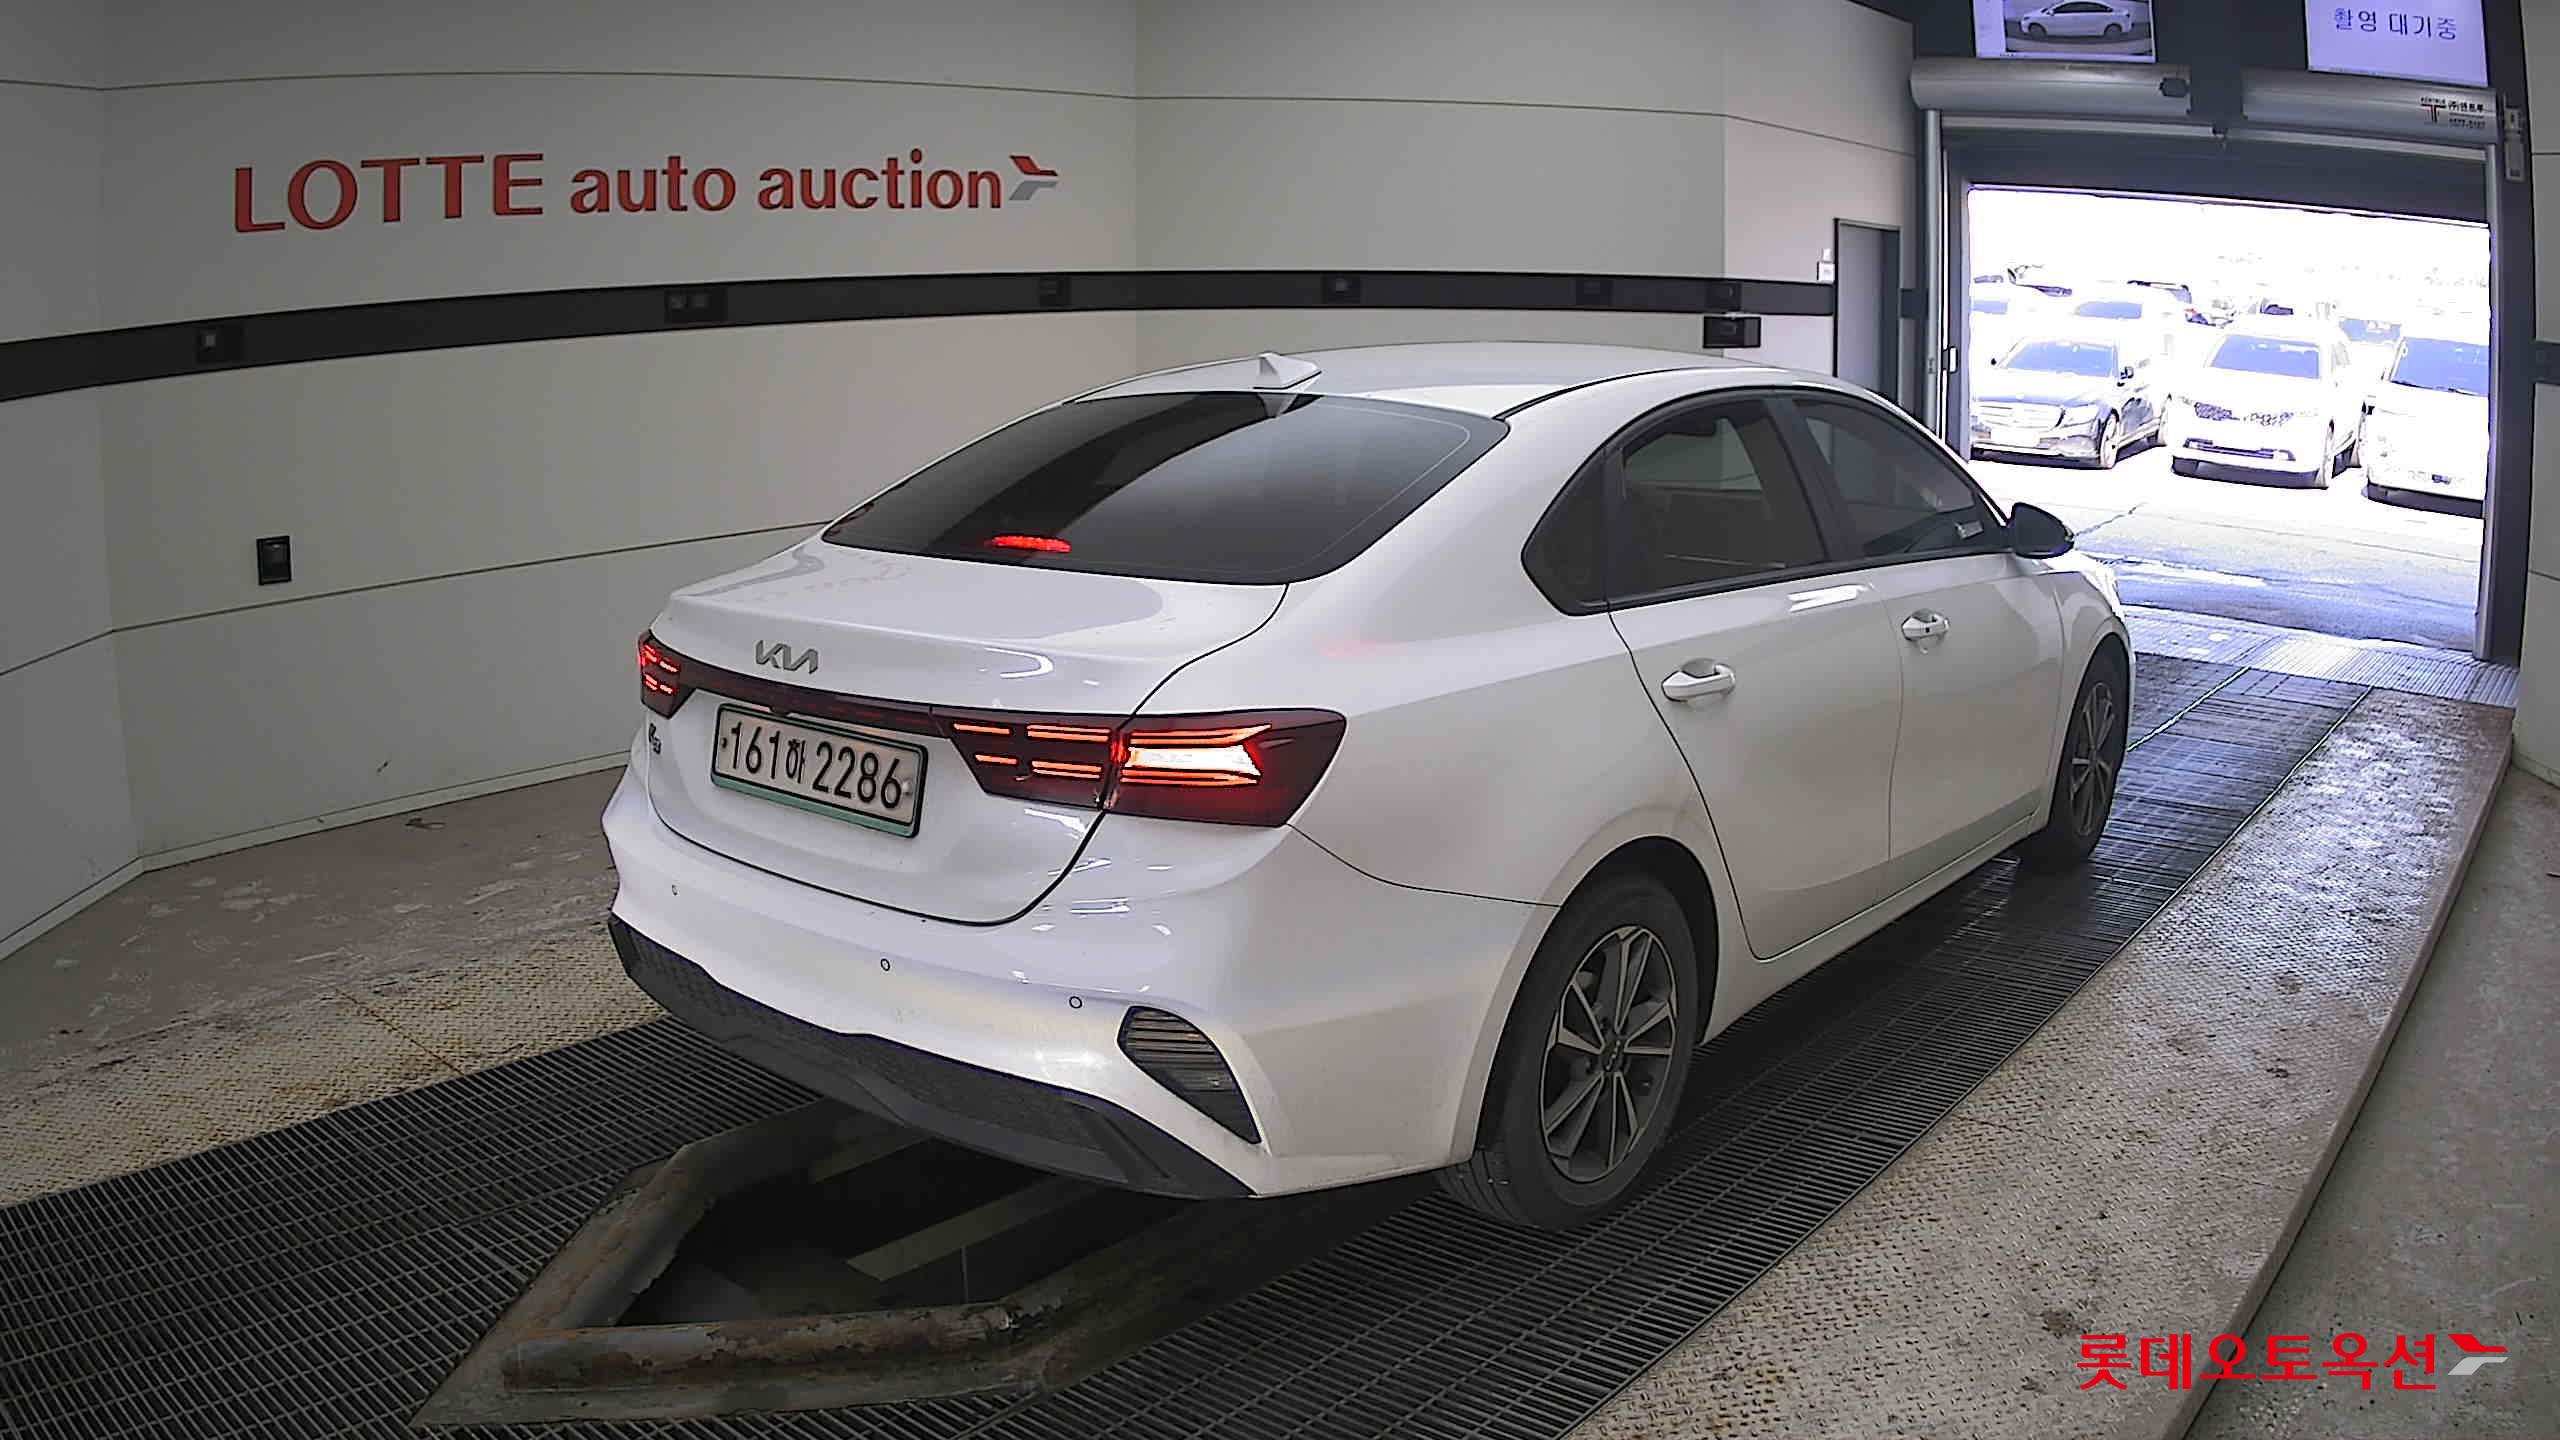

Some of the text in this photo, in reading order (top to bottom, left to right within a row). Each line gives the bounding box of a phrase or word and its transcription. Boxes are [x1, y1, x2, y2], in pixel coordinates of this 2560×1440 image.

[2334, 7, 2457, 41] 촬영 대기중
[234, 148, 1003, 233] LOTTE auto auction
[755, 639, 819, 675] KIA
